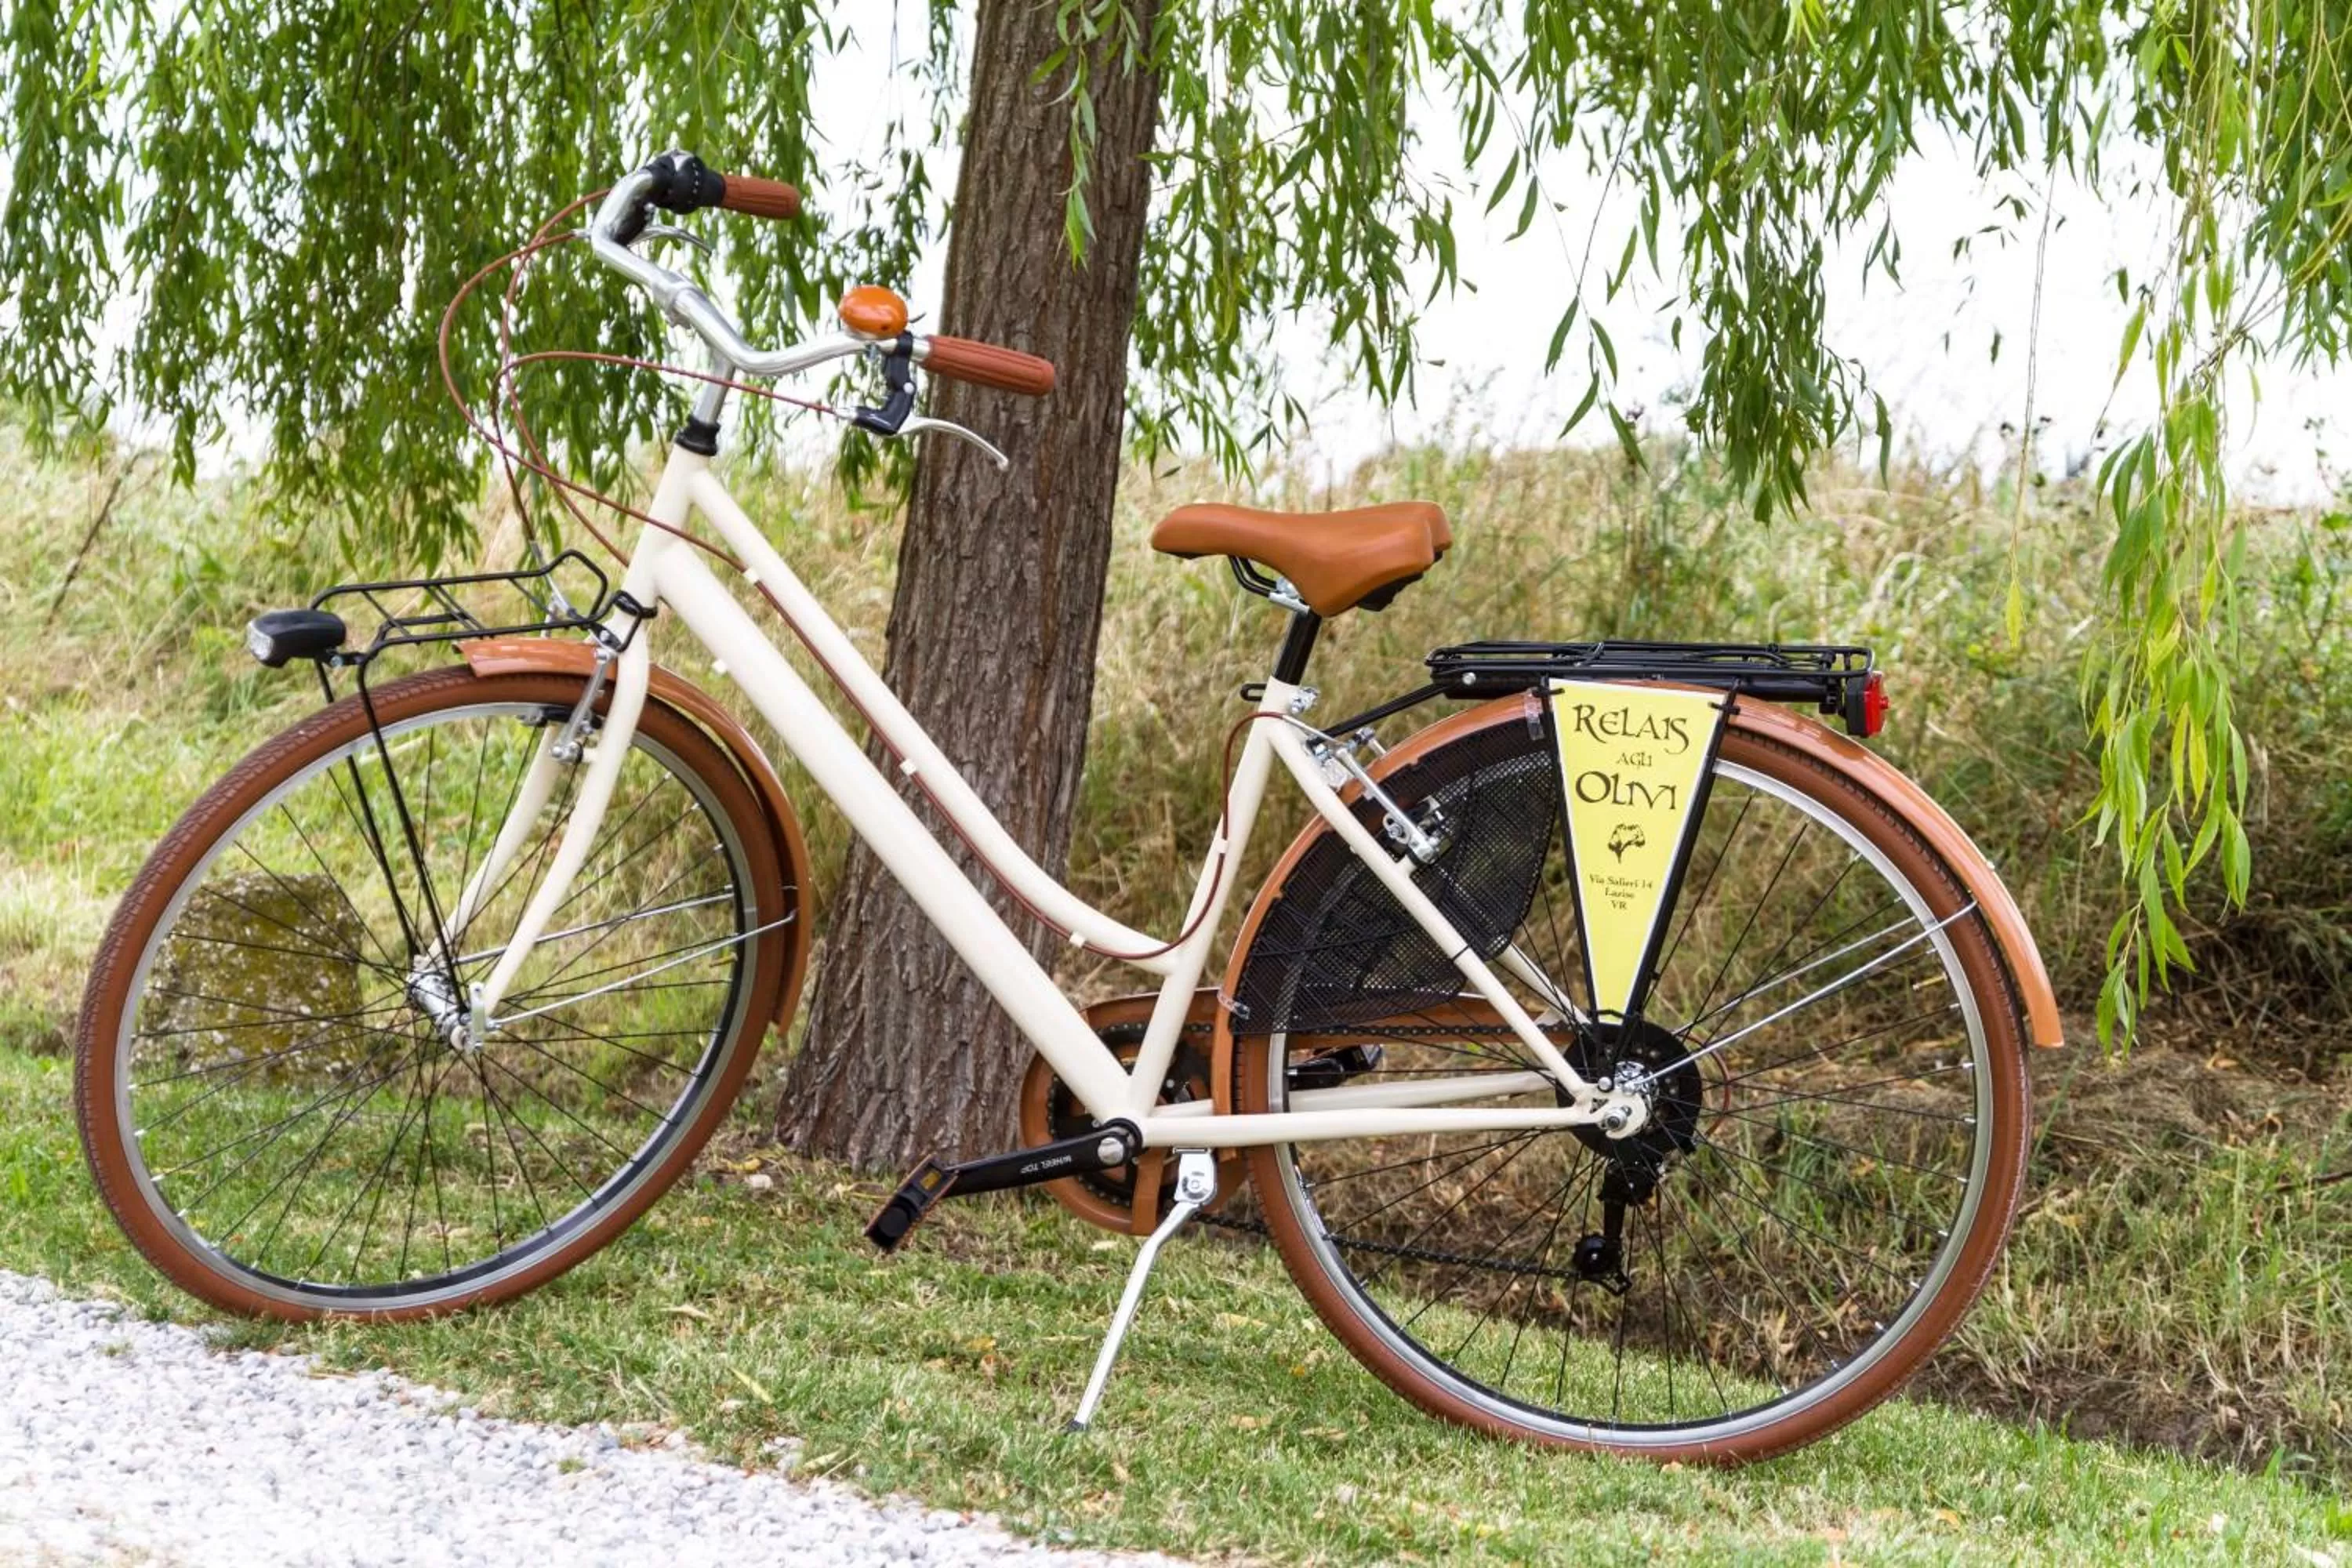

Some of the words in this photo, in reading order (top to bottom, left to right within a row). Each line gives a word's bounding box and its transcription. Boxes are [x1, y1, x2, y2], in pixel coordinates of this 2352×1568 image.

[1572, 703, 1690, 755] RELAIS
[1615, 752, 1653, 769] AGLI
[1575, 771, 1677, 811] OLIVI
[1589, 873, 1605, 884] Via
[1607, 876, 1639, 888] Salieri
[1642, 879, 1653, 889] 14
[1610, 899, 1628, 910] VR
[1020, 1163, 1039, 1174] TOP
